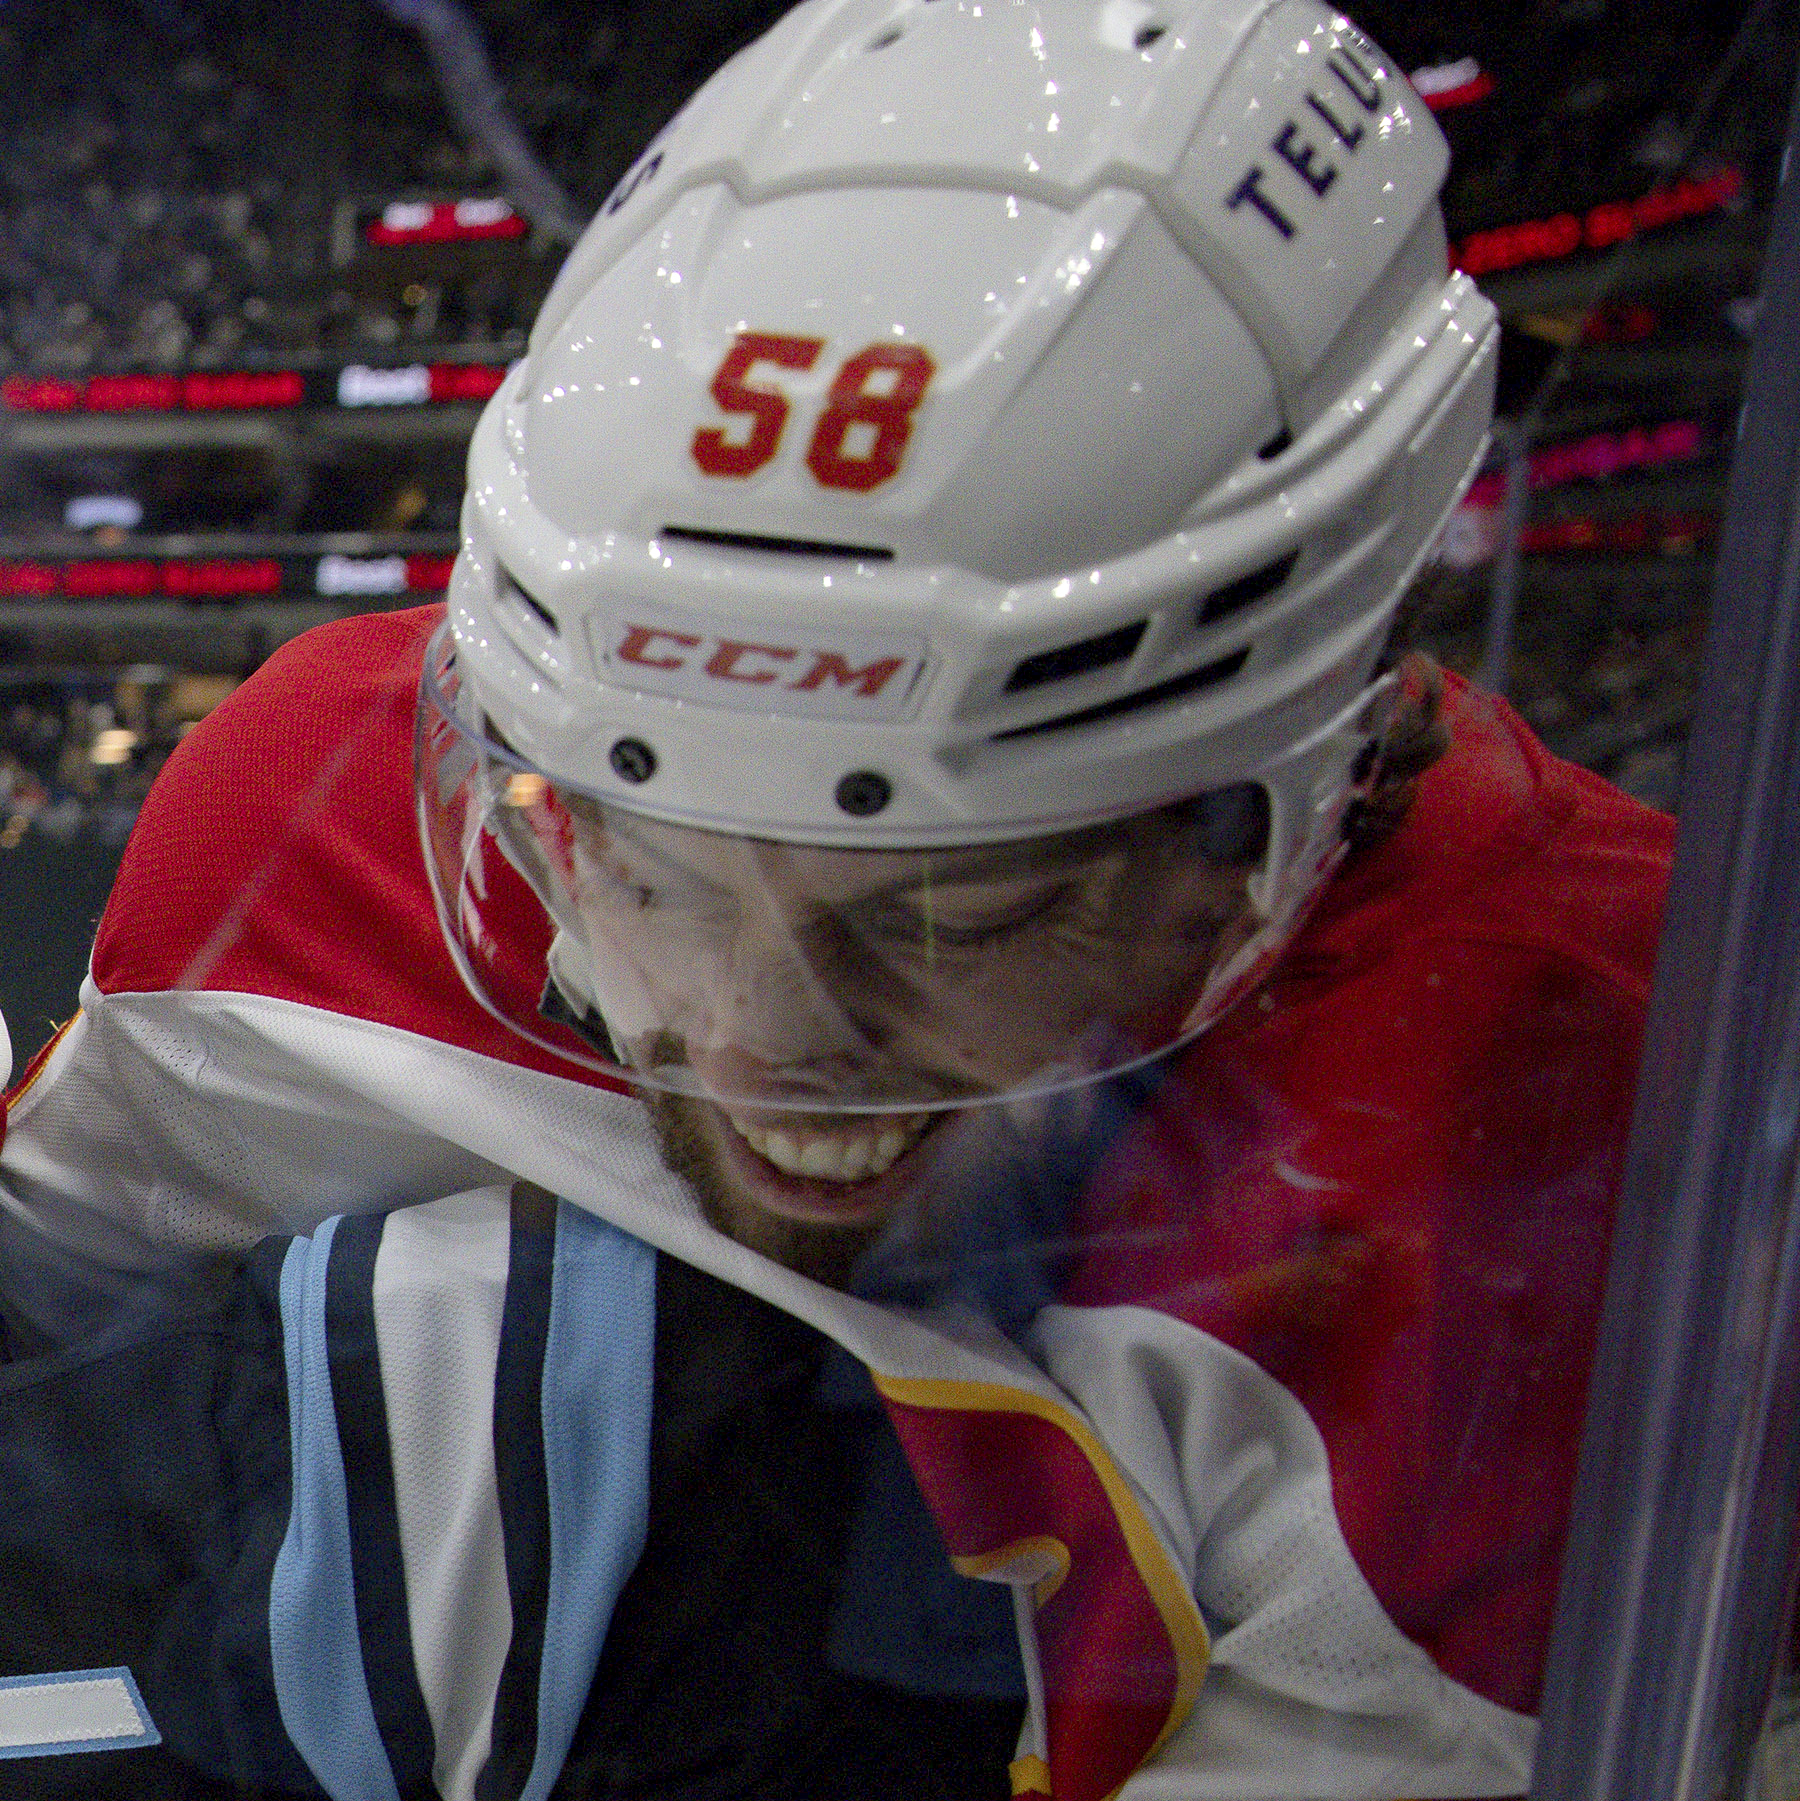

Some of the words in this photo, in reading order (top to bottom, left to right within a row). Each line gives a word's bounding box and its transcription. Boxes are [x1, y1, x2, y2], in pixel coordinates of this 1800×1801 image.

[1225, 38, 1385, 242] TELU
[689, 331, 939, 495] 58
[615, 621, 909, 701] CCM
